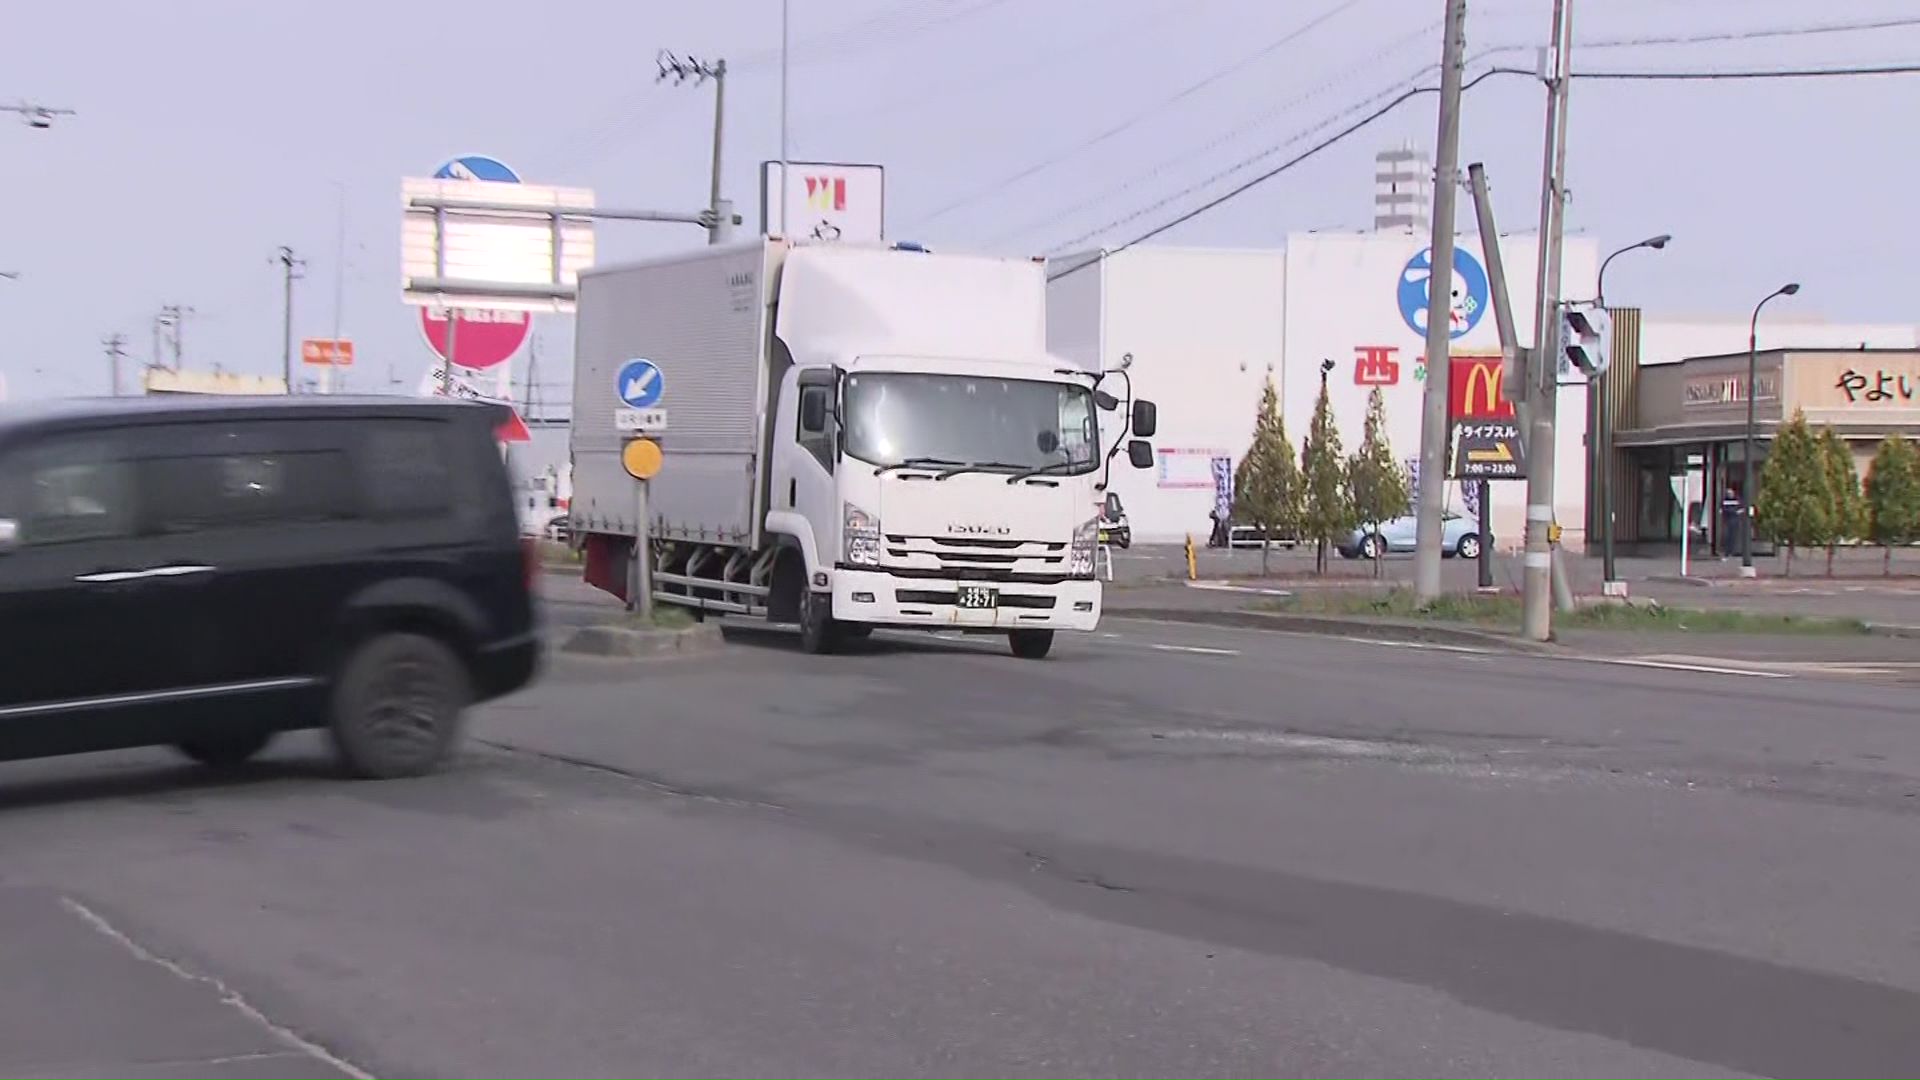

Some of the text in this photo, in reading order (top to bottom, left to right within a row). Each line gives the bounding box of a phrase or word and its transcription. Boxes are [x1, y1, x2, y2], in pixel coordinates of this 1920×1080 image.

[1455, 425, 1518, 439] ライブスル
